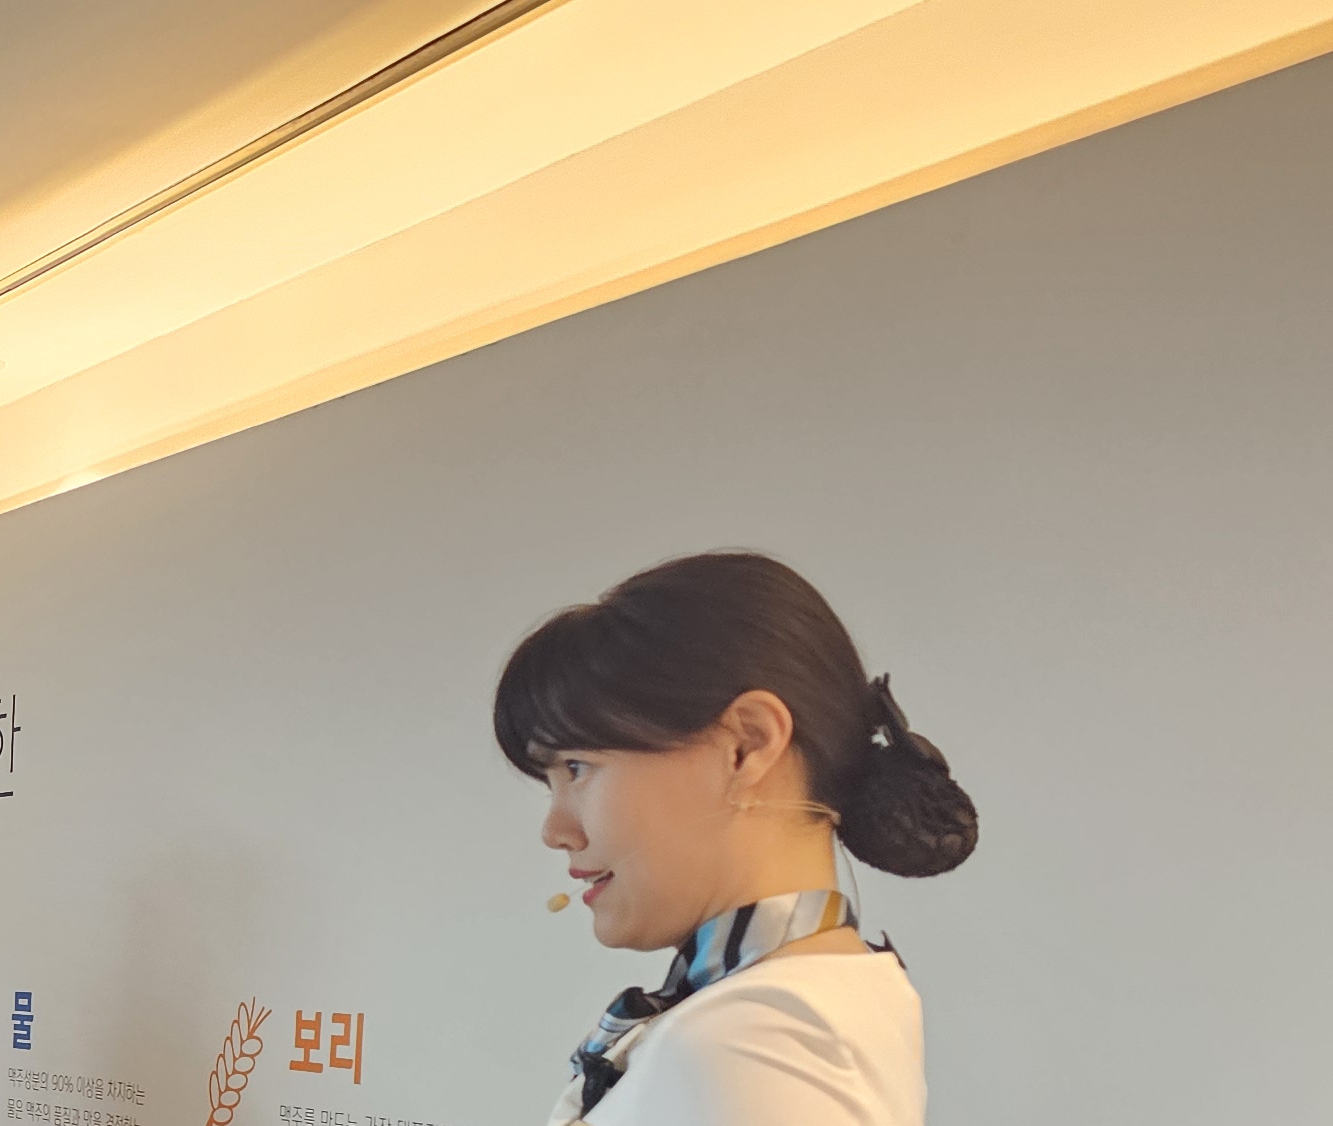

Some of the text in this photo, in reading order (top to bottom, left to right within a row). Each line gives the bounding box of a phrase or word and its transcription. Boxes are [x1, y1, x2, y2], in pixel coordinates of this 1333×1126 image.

[12, 992, 34, 1050] 물
[289, 1010, 365, 1085] 보리
[7, 1099, 23, 1120] 물은
[26, 1102, 51, 1123] 맥주의
[52, 1075, 73, 1093] 90%
[77, 1077, 104, 1100] 이상을
[107, 1081, 145, 1106] 차지하는
